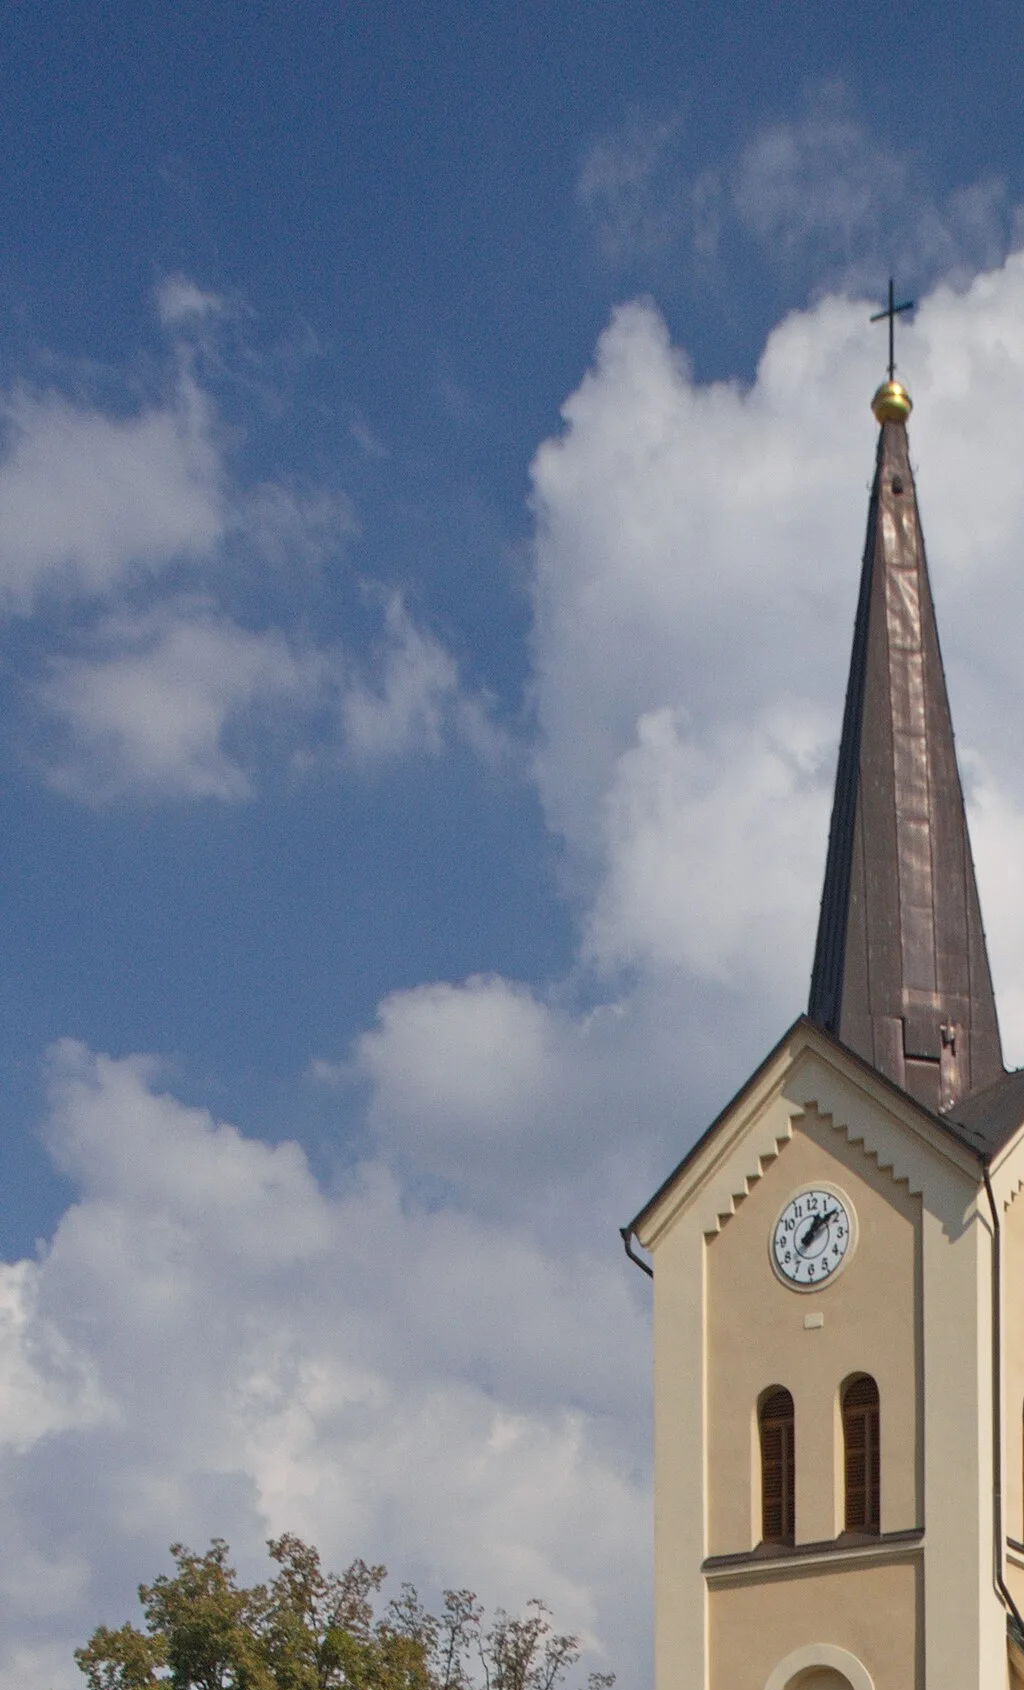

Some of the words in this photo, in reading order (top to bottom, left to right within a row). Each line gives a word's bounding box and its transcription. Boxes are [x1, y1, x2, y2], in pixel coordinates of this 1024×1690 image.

[806, 1197, 819, 1212] 12
[794, 1205, 803, 1219] 11
[784, 1218, 796, 1232] 10
[836, 1226, 844, 1239] 3
[780, 1235, 787, 1248] 9
[831, 1243, 839, 1256] 4
[784, 1251, 792, 1264] 8
[821, 1257, 829, 1271] 5
[795, 1260, 802, 1274] 7
[807, 1263, 815, 1276] 6
